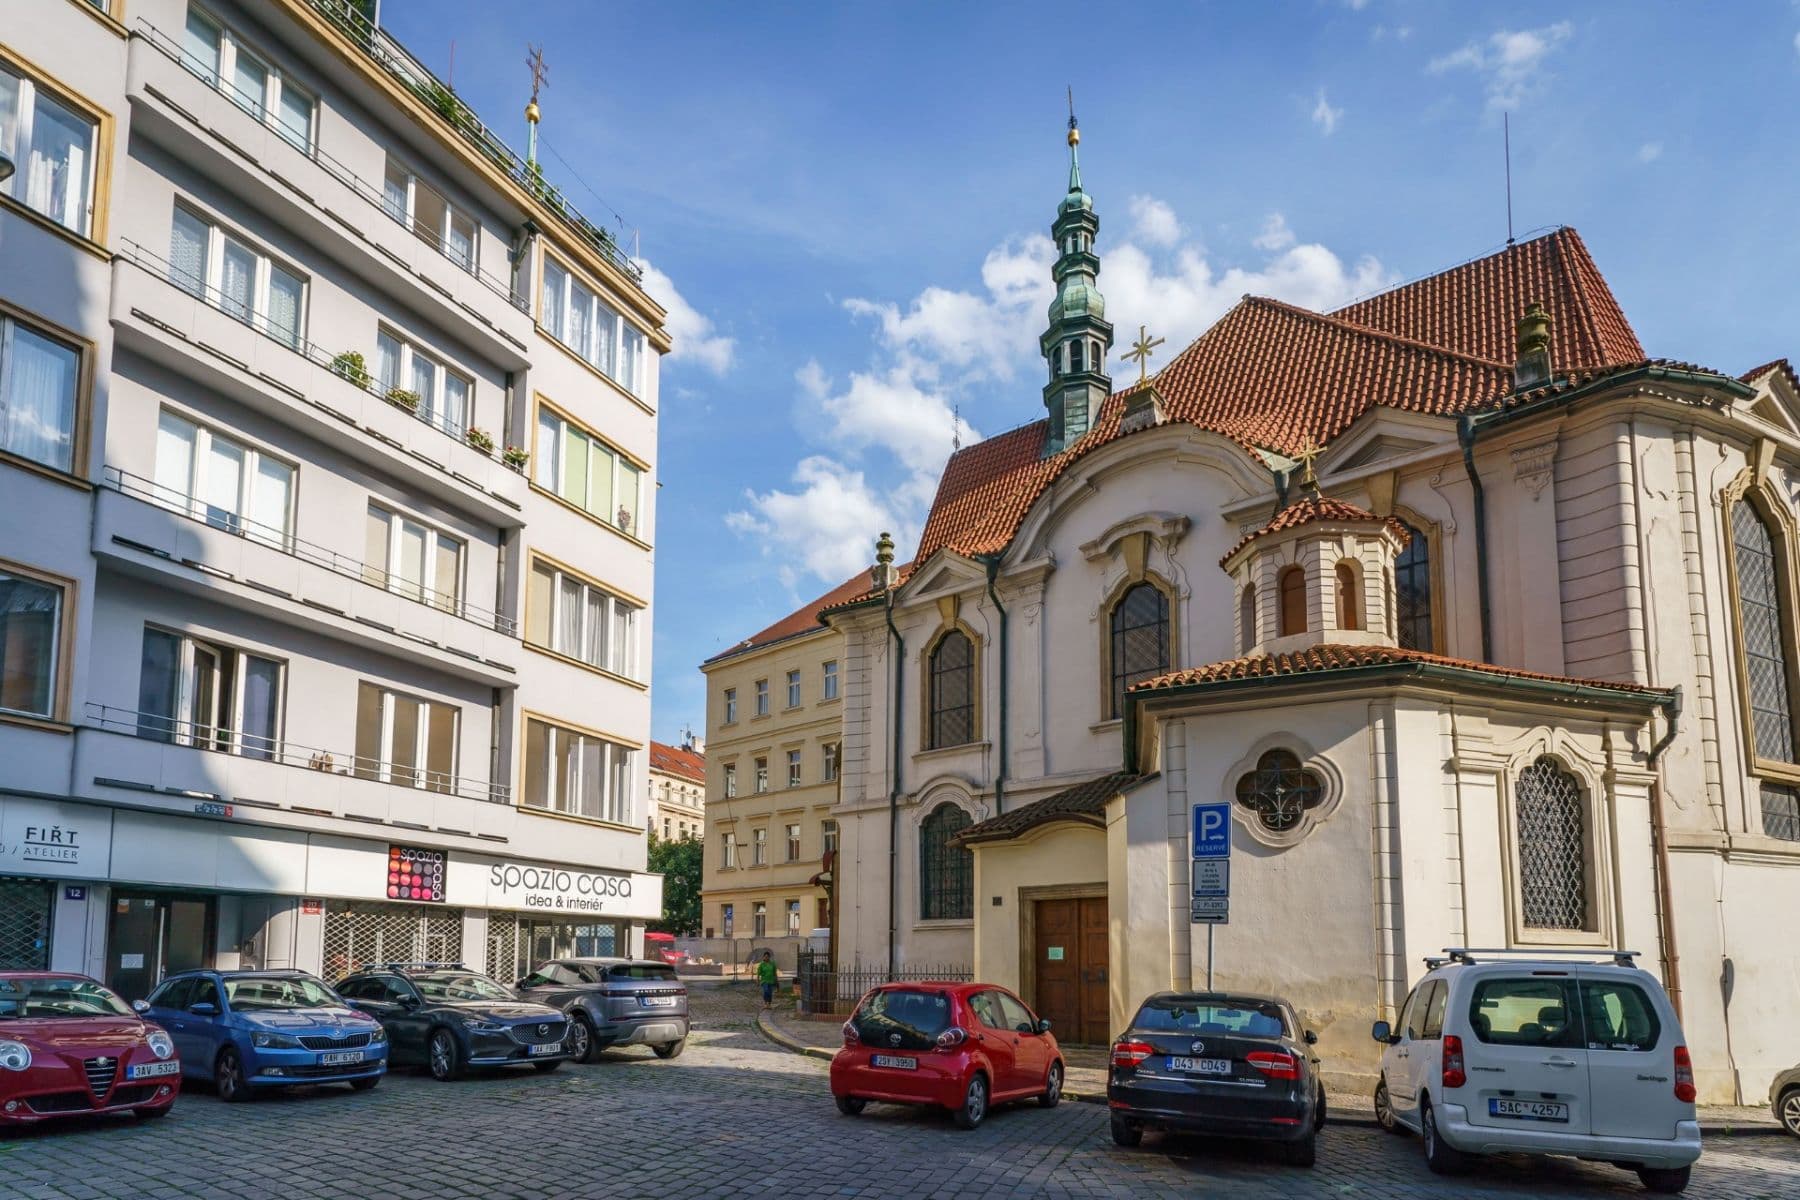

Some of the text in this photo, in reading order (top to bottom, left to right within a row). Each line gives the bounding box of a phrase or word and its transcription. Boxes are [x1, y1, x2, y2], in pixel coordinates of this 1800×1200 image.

[1201, 811, 1222, 841] P
[26, 826, 78, 844] FIŘT
[23, 847, 78, 859] ATELIER
[400, 848, 443, 863] spazio
[431, 863, 443, 900] casa
[491, 863, 632, 898] spazio casa
[71, 888, 81, 897] 12
[525, 894, 603, 911] idea & interiér
[135, 1065, 152, 1076] 3AV
[1200, 1060, 1227, 1071] CD49
[1499, 1101, 1561, 1117] 5AC 4257
